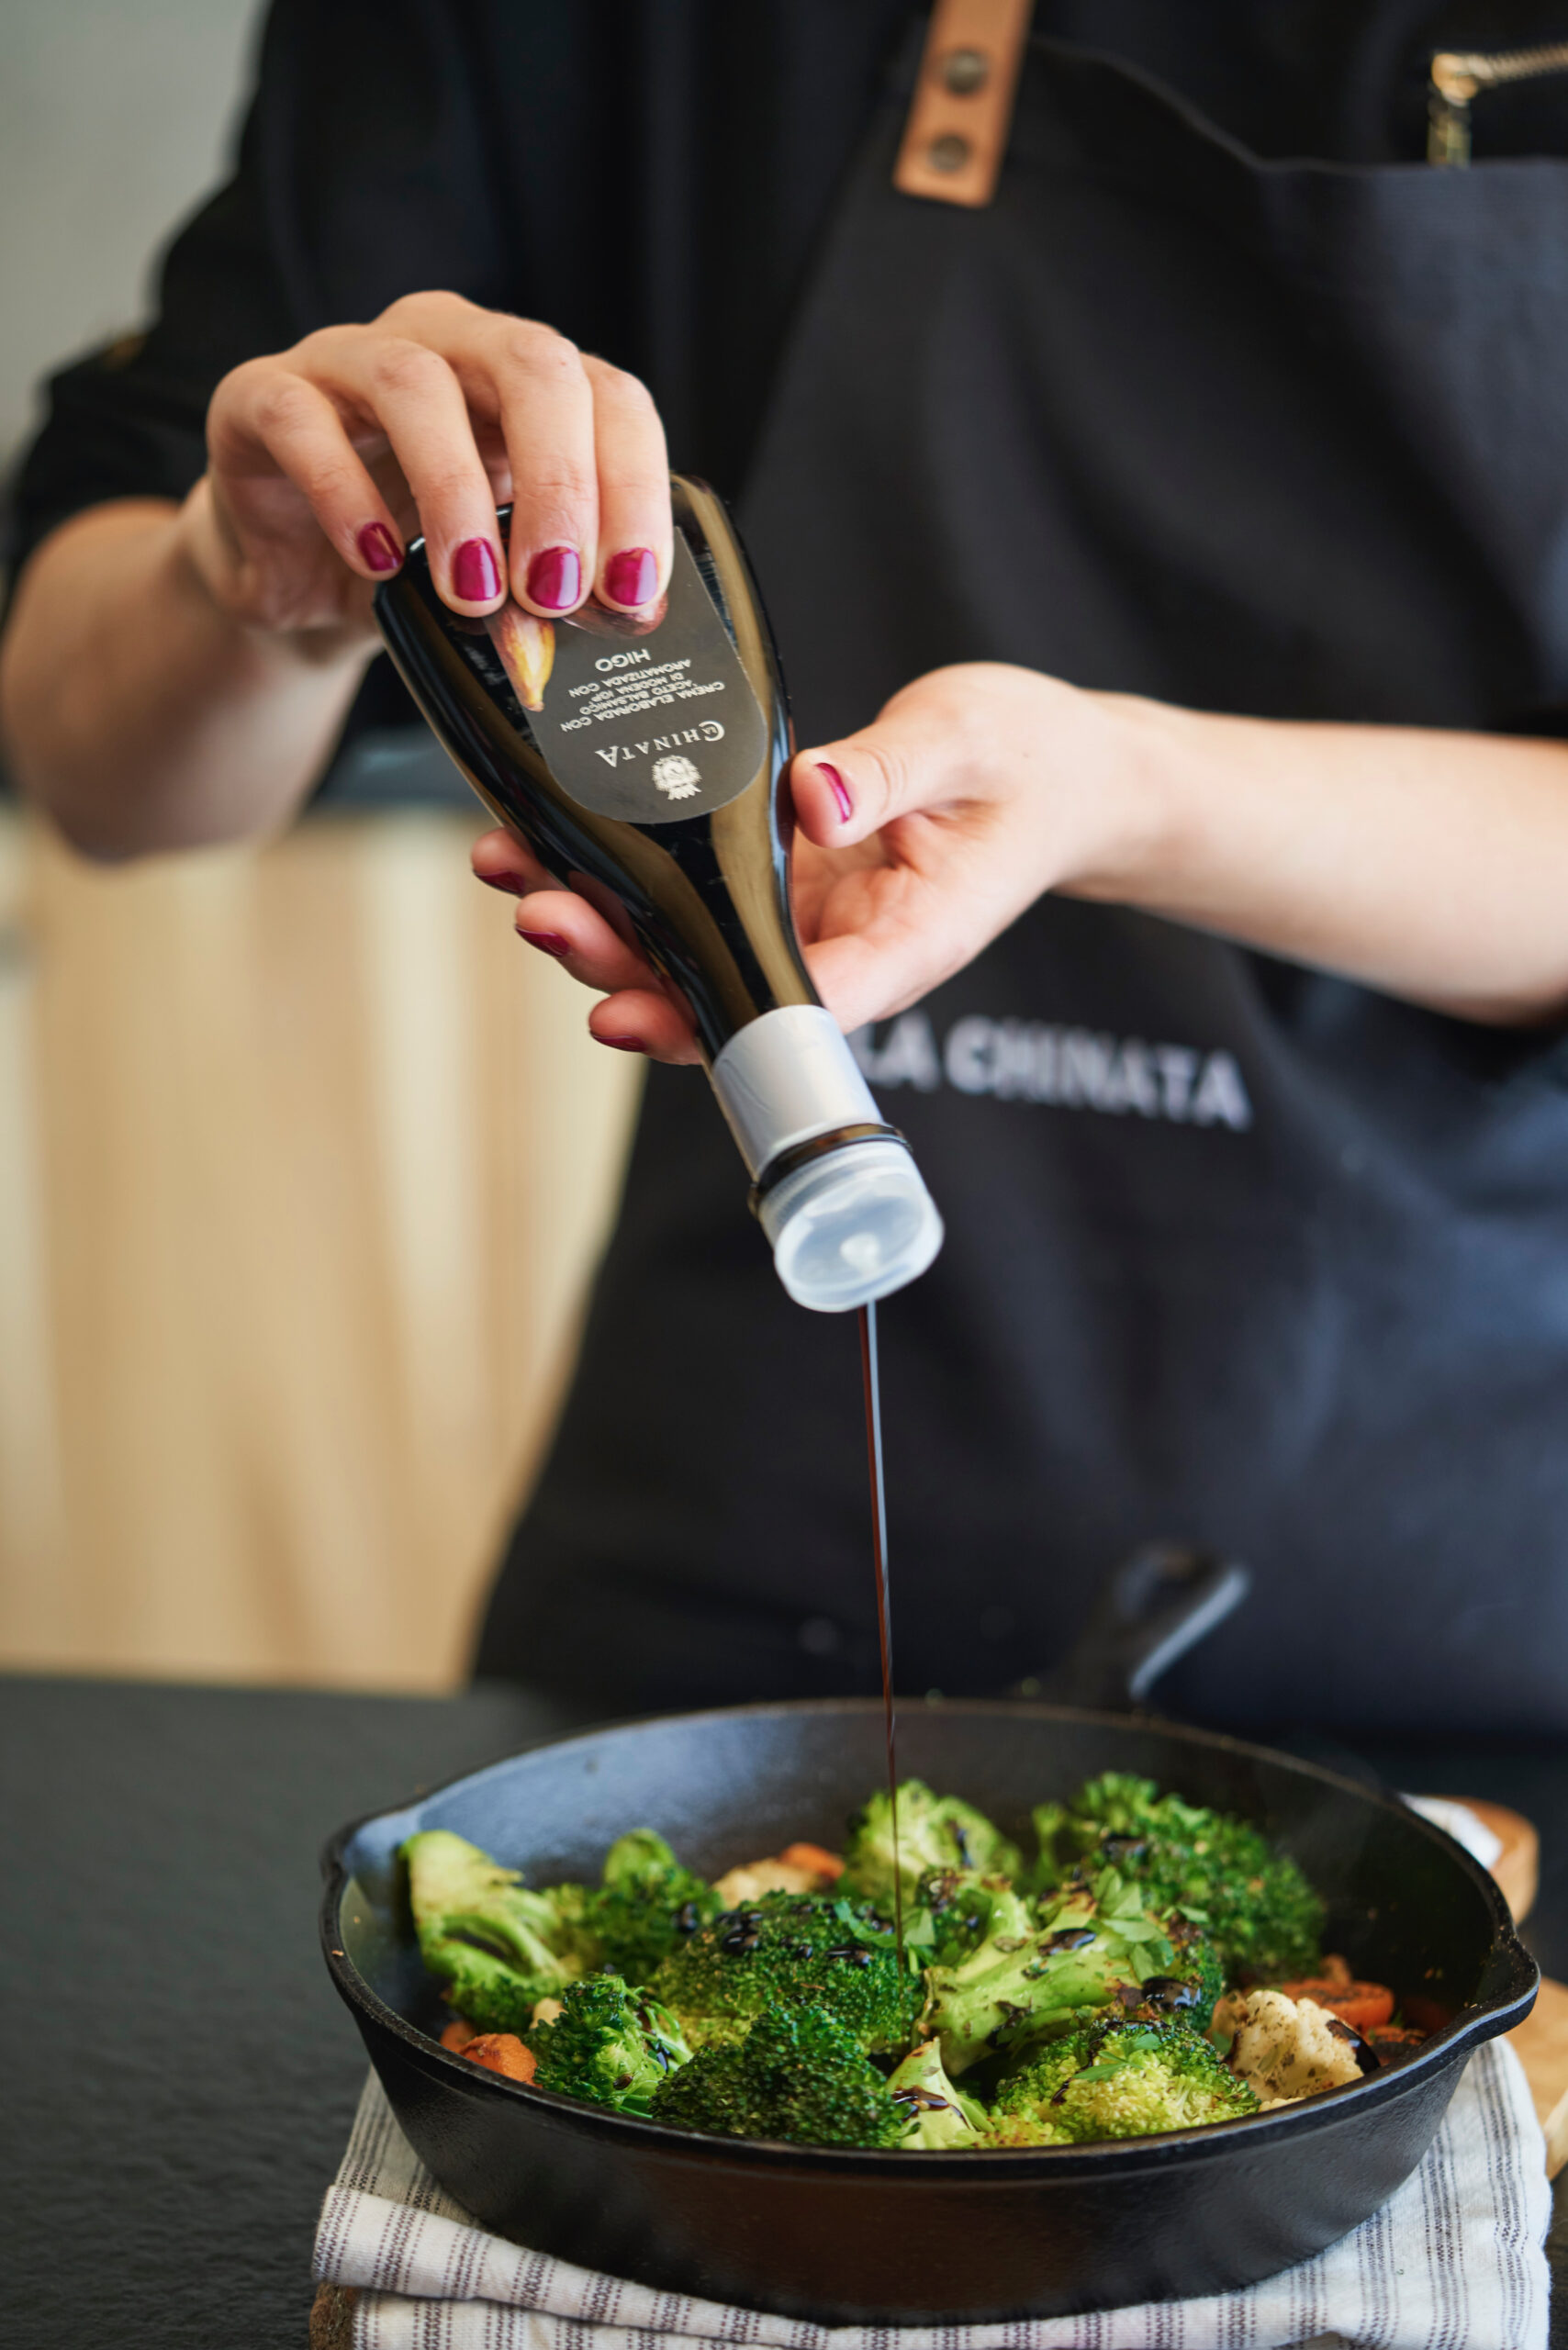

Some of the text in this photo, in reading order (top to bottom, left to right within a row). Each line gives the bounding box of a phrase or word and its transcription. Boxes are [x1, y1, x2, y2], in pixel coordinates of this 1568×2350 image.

[594, 648, 652, 672] HIGO
[568, 658, 691, 698] AROMATIZADA CON
[614, 676, 668, 695] MODENA
[668, 672, 685, 682] DI
[559, 681, 725, 733] CREMA ELABORADA CON
[579, 689, 650, 715] BALSAMICO
[595, 720, 725, 768] CHINATA
[846, 1010, 1254, 1134] LA CHINATA
